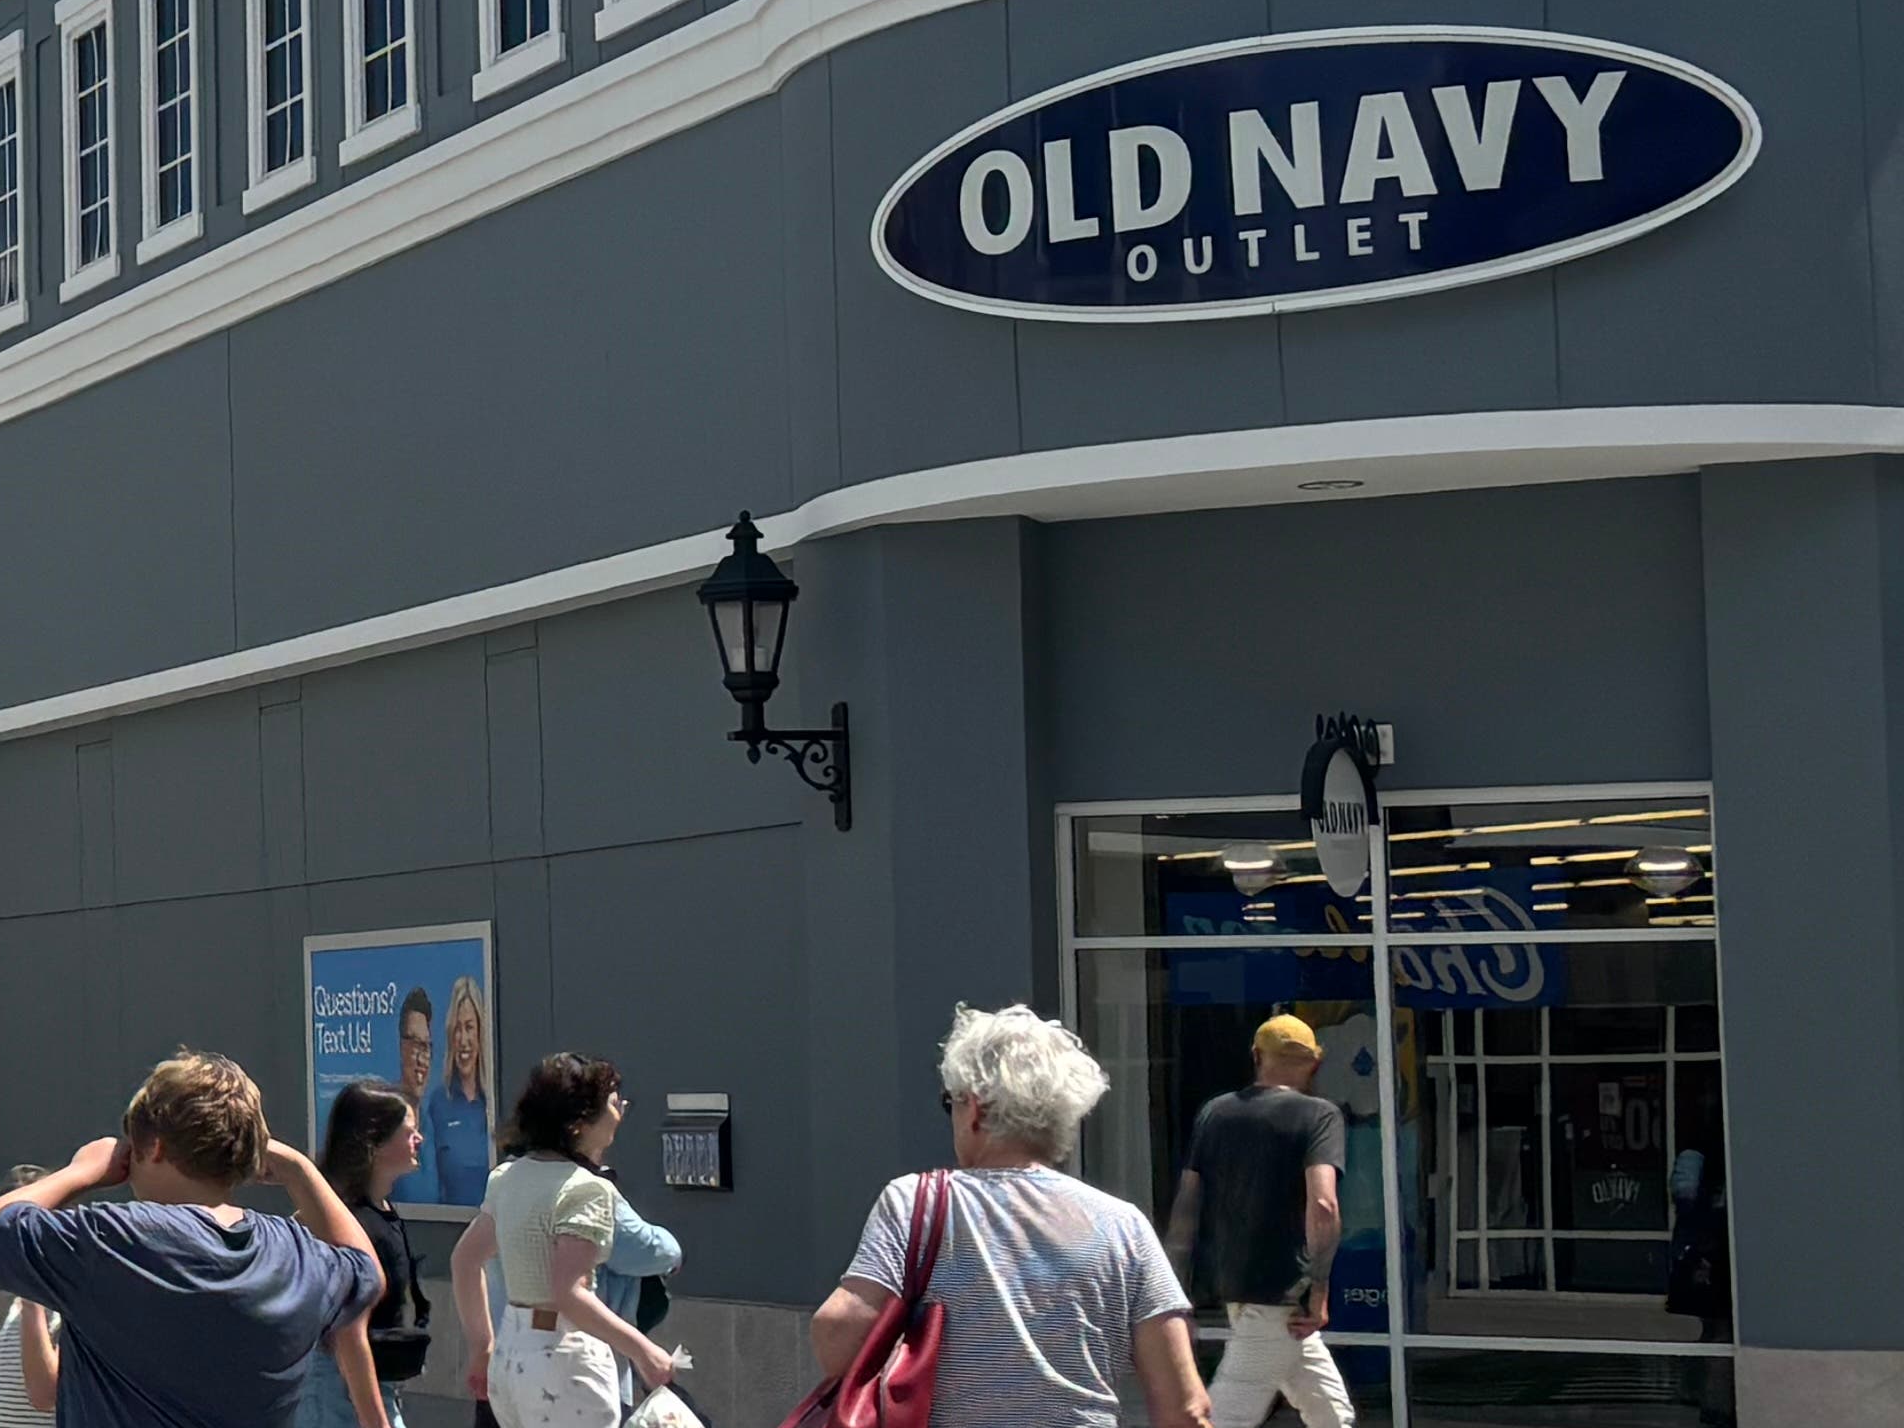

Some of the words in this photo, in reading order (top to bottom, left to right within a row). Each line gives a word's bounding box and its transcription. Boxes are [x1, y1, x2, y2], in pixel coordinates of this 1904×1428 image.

[958, 123, 1191, 256] OLD
[1228, 70, 1628, 217] NAVY
[1127, 209, 1430, 283] OUTLET
[314, 982, 397, 1017] Questions?
[315, 1023, 347, 1055] Text
[349, 1021, 372, 1054] Us!
